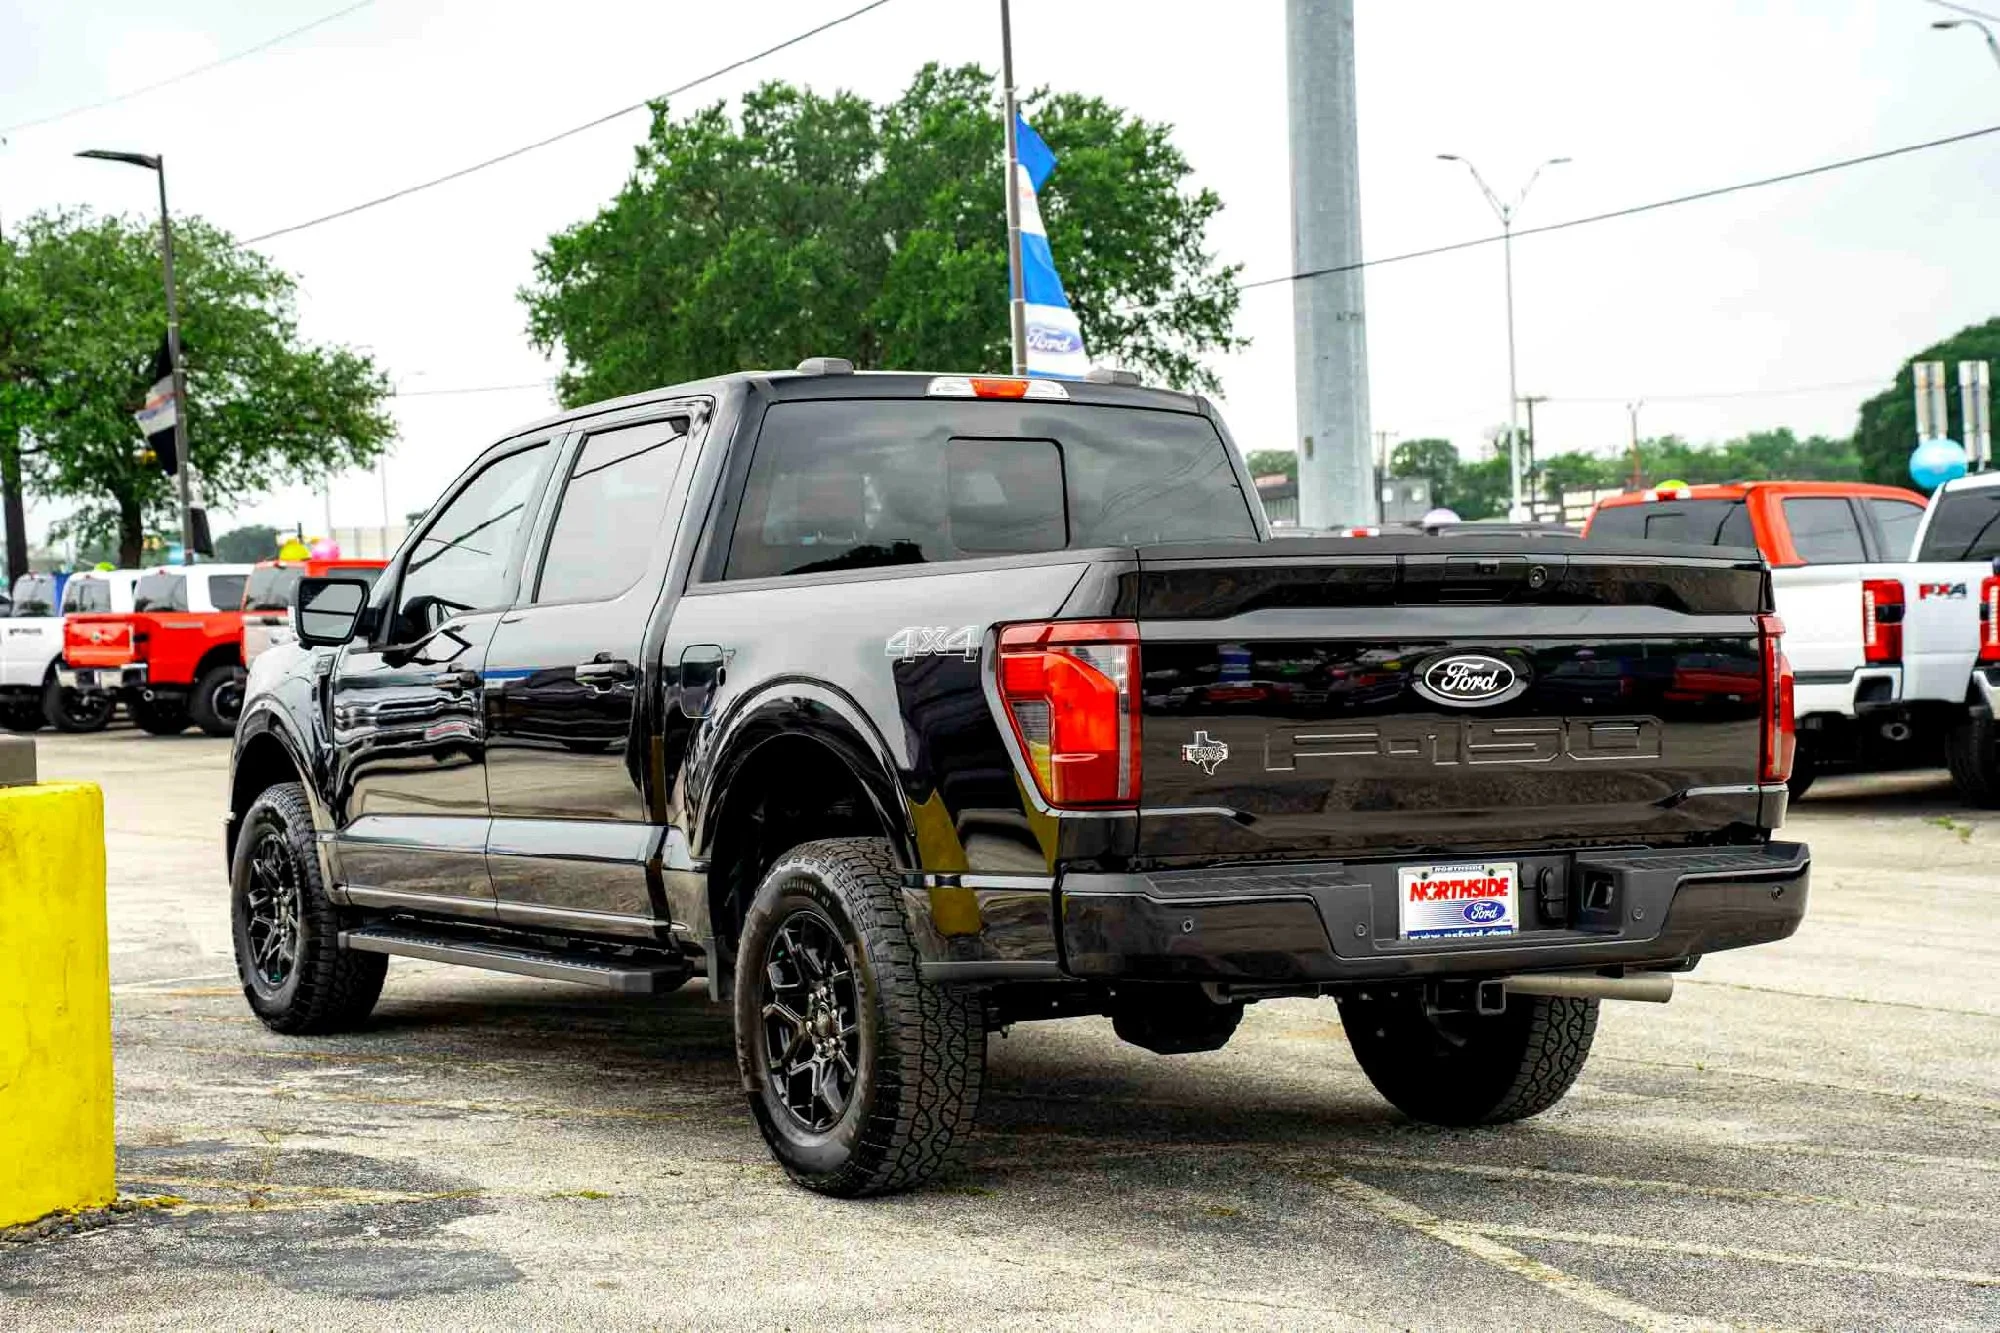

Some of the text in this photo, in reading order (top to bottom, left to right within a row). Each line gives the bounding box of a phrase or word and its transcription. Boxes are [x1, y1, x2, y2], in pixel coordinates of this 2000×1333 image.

[1026, 327, 1070, 352] Ford
[1919, 583, 1967, 600] FX4
[1441, 662, 1499, 691] Ford
[1187, 747, 1225, 760] TEXAS
[1264, 716, 1662, 771] F-150
[1410, 877, 1509, 901] NORTHSIDE
[1470, 903, 1498, 919] Ford
[1409, 929, 1512, 940] wwwnsford.com
